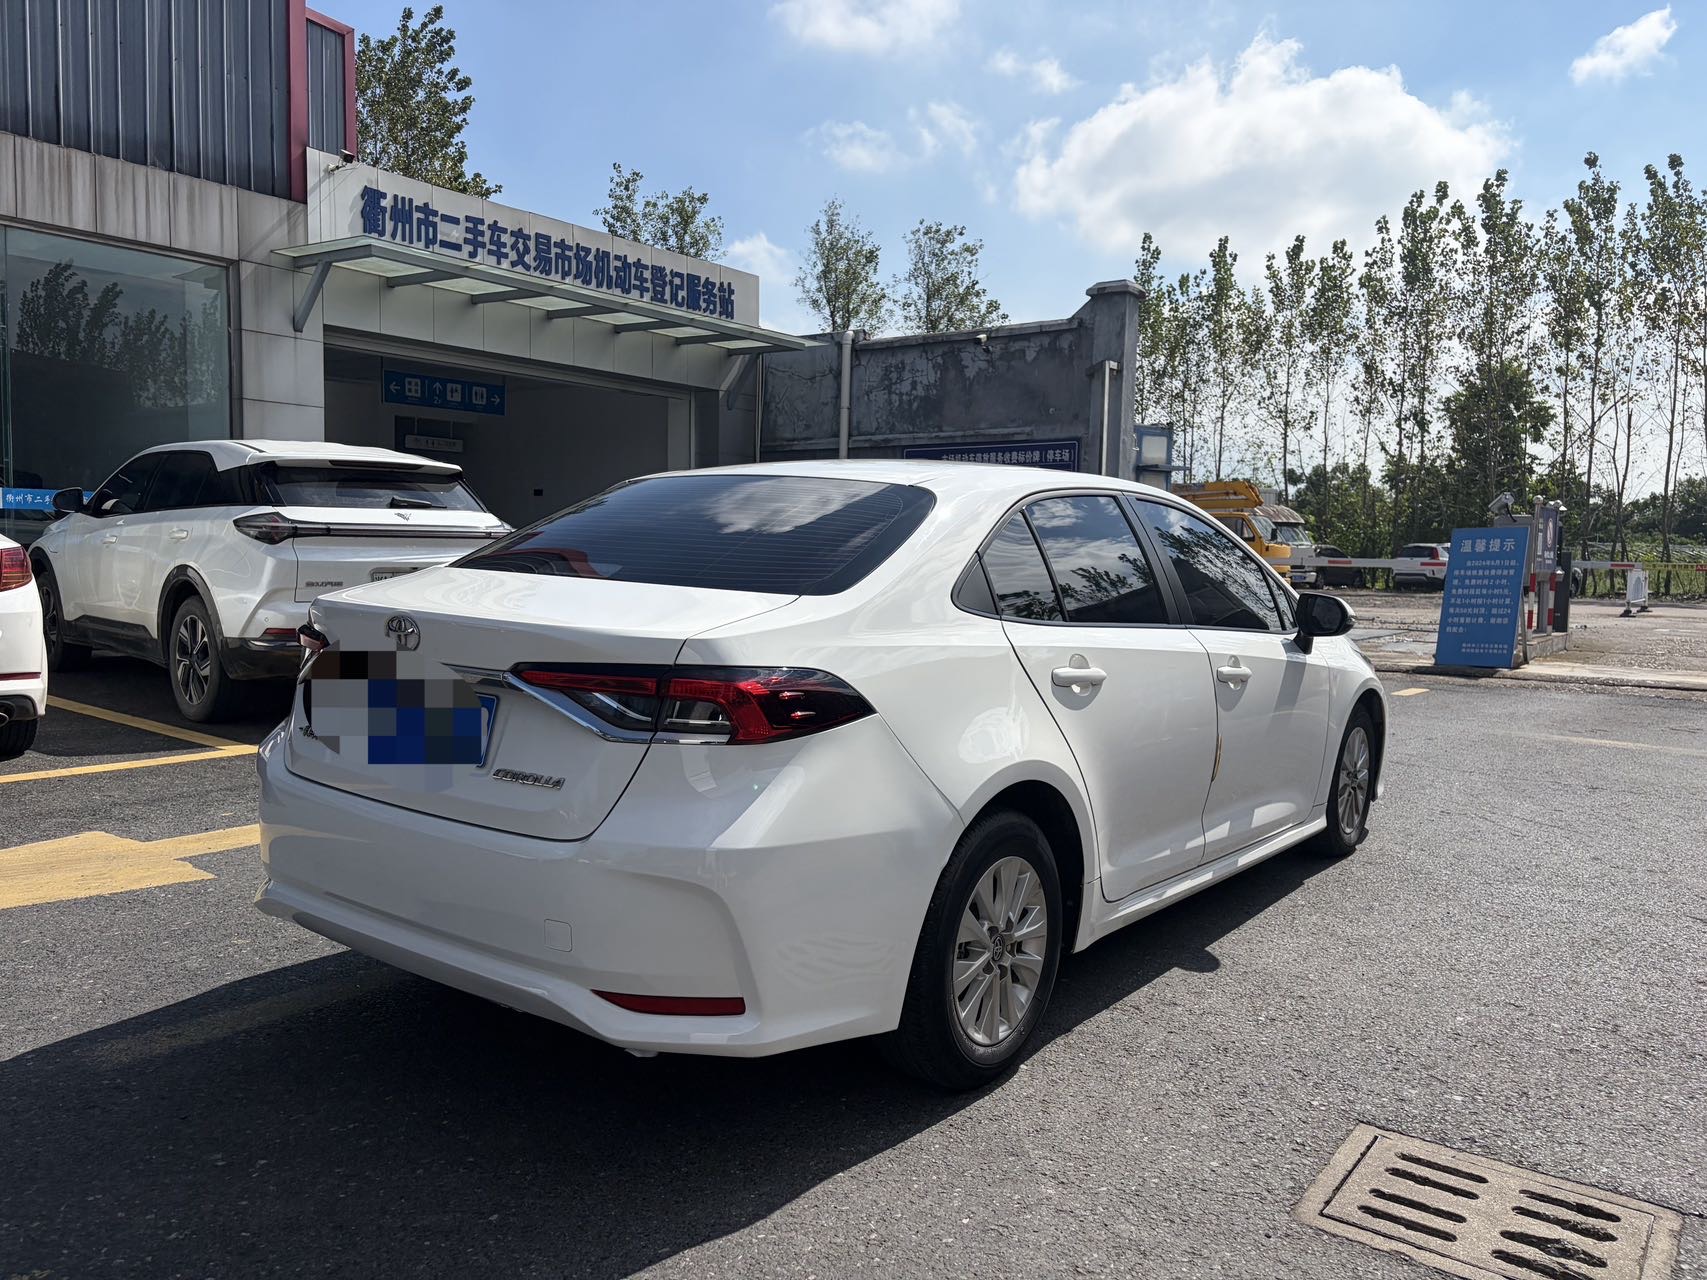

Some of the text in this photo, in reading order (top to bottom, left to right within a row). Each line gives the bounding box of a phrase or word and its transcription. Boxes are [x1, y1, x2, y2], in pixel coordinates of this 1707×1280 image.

[360, 184, 735, 319] 衢州市二手车交易市场机动车登记服务站
[6, 493, 52, 504] 衢州市二手
[1460, 538, 1516, 553] 温馨提示
[492, 768, 566, 790] COROLLA
